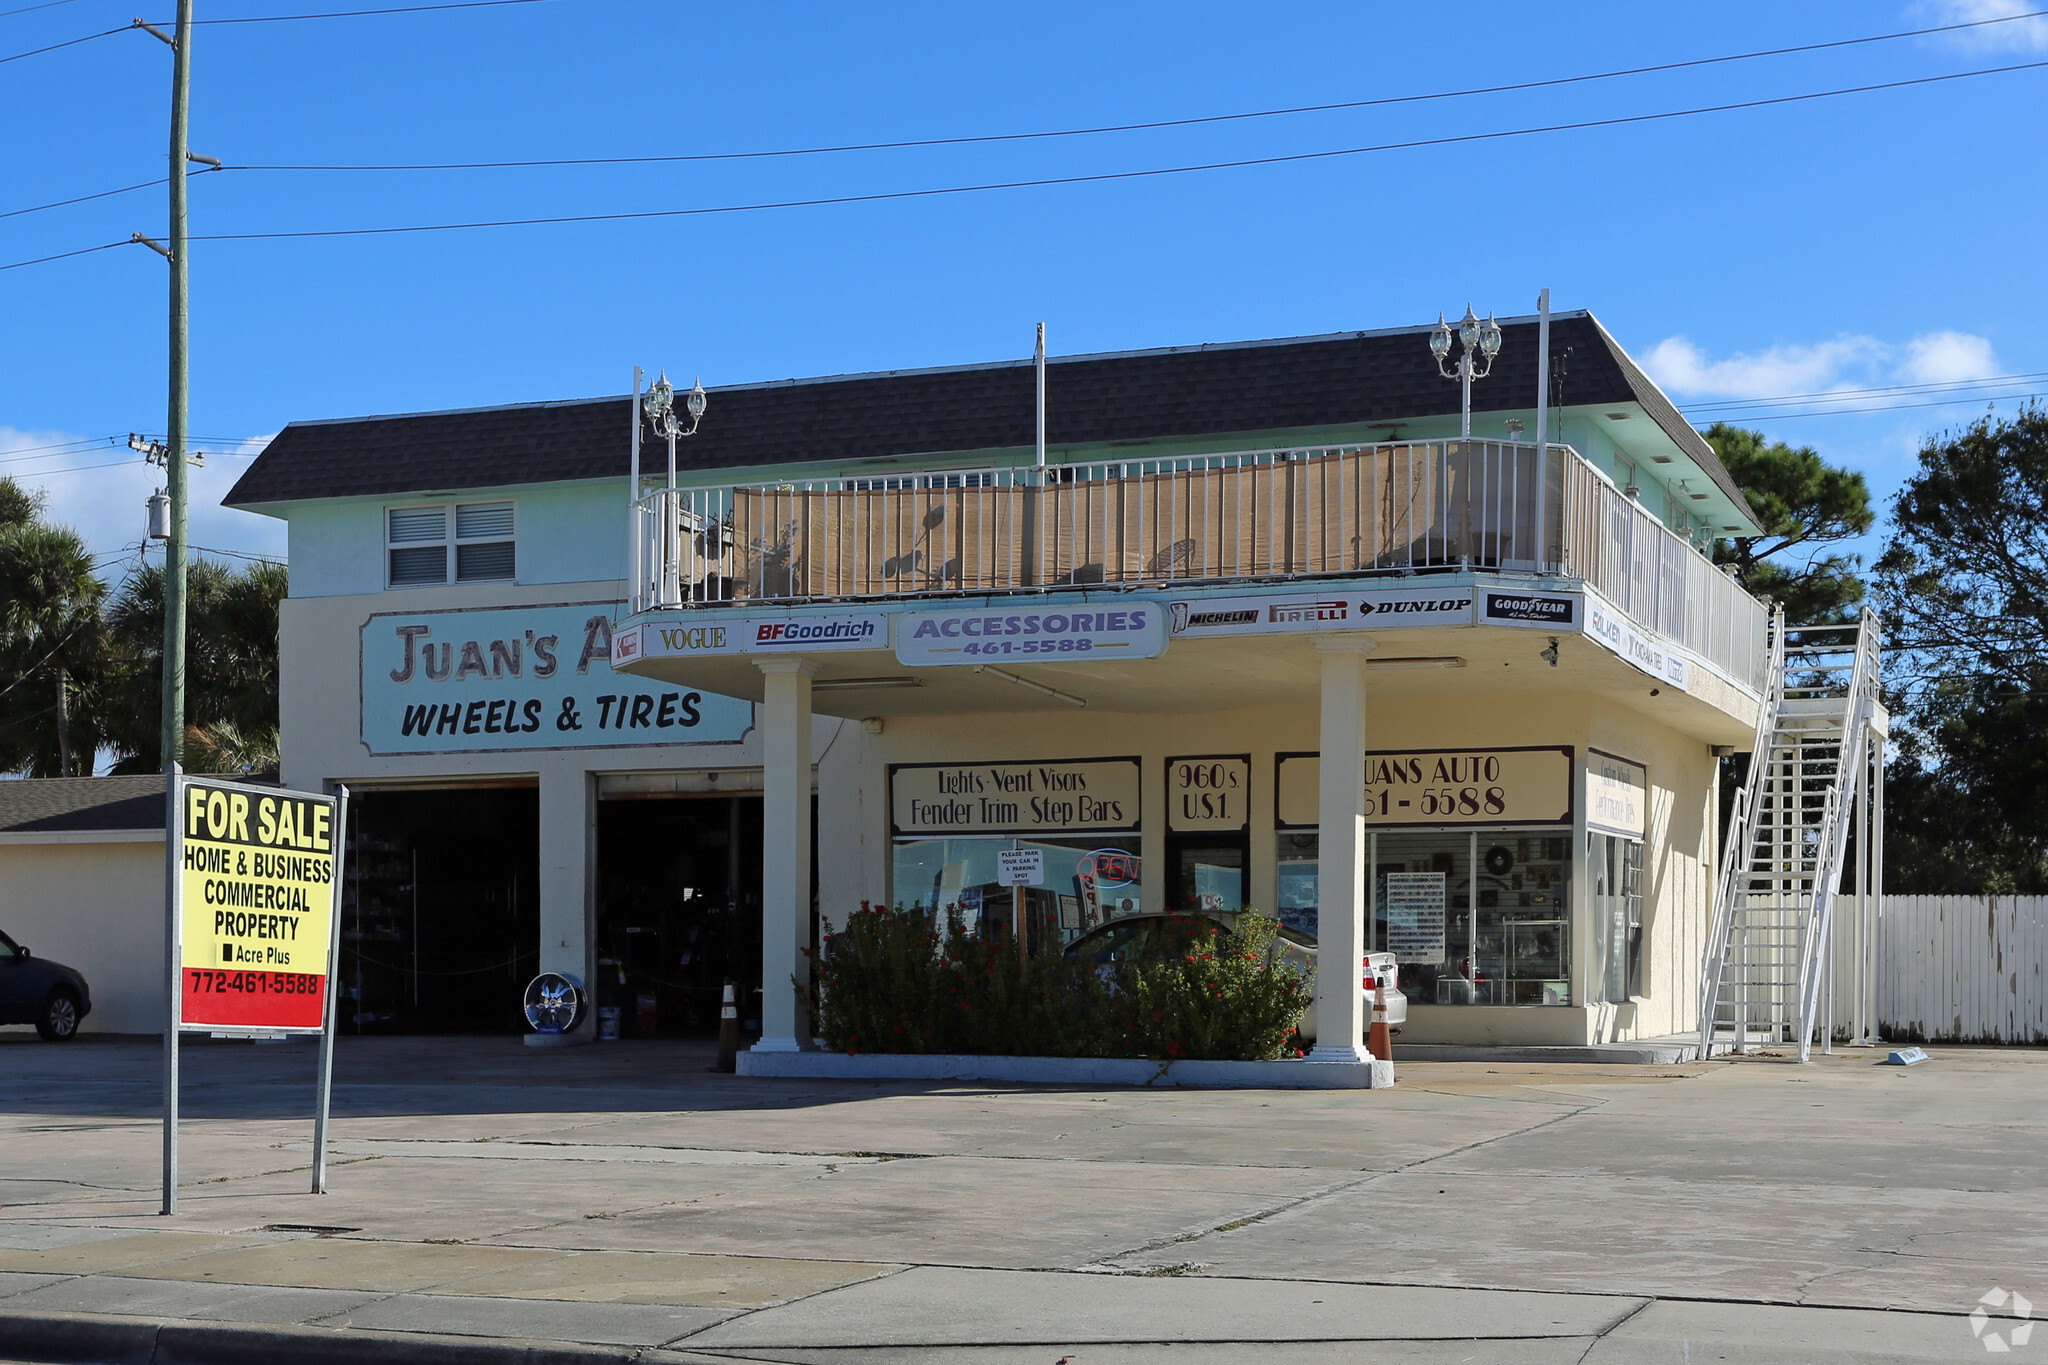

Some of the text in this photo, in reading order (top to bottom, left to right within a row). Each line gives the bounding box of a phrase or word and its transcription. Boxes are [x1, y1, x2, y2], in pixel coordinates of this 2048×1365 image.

[1189, 610, 1256, 624] MICHELIN
[1269, 601, 1348, 622] PIRELLI
[1375, 599, 1472, 614] DUNLOP
[1495, 599, 1565, 613] GOODYEAR
[660, 626, 726, 650] VOGUE
[756, 620, 874, 641] BFGoodrich
[913, 611, 1146, 639] ACCESSORIES
[389, 625, 559, 683] JUAN'S
[963, 638, 1093, 655] 461-5588
[401, 692, 701, 737] WHEELS & TIRES
[938, 768, 1086, 796] Lights Vent Visors
[1179, 764, 1225, 788] 960
[1365, 756, 1499, 785] UANS AUTO
[911, 795, 1123, 826] Fender Trim Step Bars
[1364, 788, 1388, 816] 61
[1421, 787, 1505, 816] 5588
[189, 787, 330, 850] FOR SALE
[184, 845, 331, 884] HOME & BUSINESS
[1077, 856, 1140, 879] OPEN
[204, 880, 310, 912] COMMERCIAL
[215, 911, 299, 940] PROPERTY
[236, 945, 290, 965] Acre Plus
[191, 972, 317, 994] 772-461-5588
